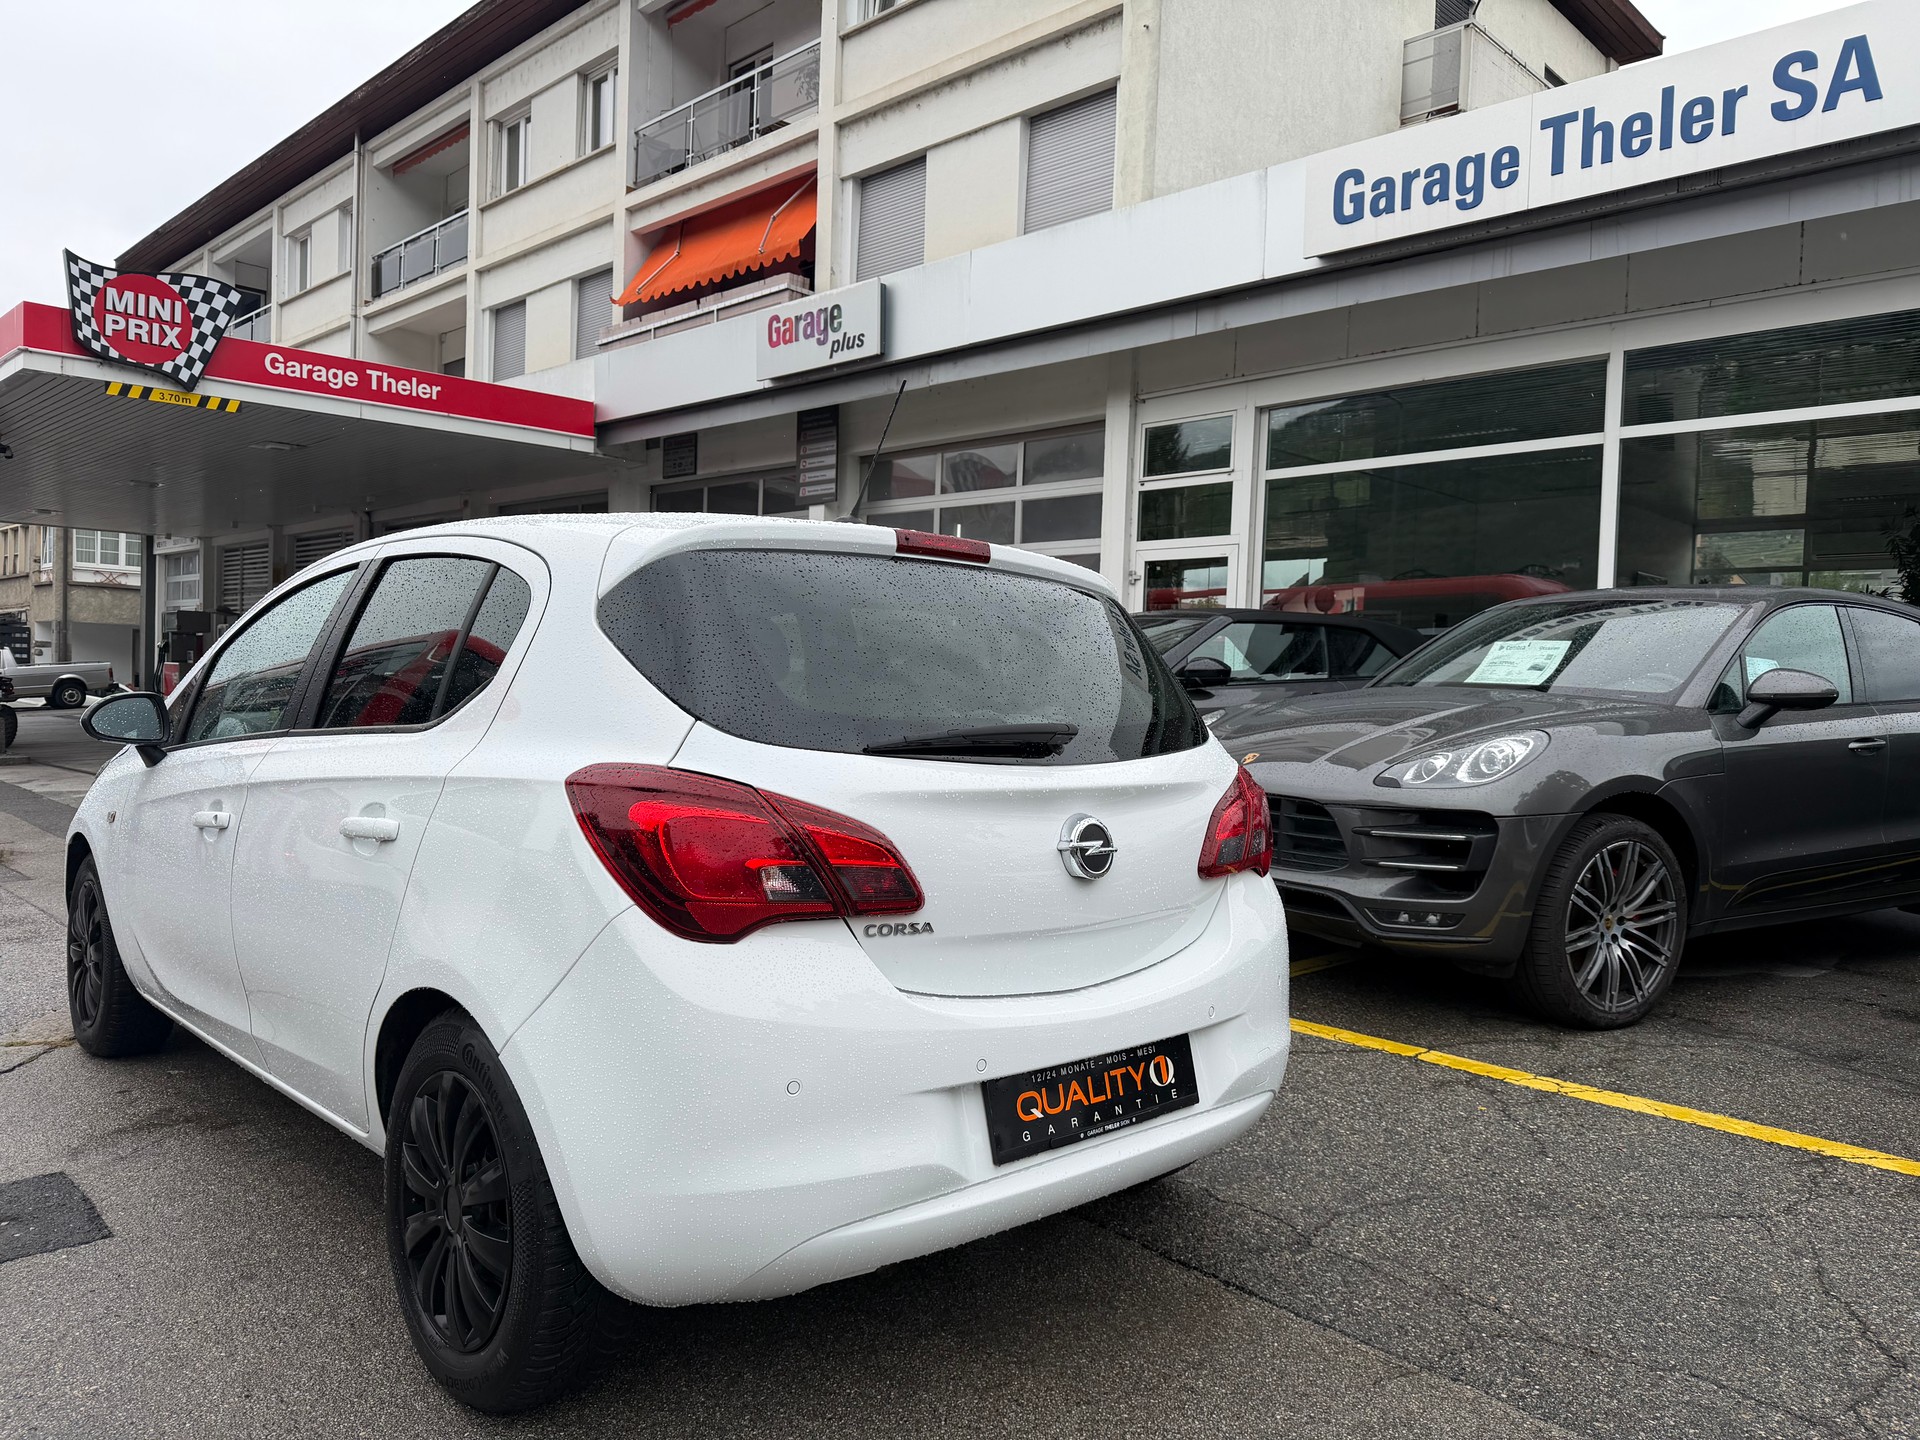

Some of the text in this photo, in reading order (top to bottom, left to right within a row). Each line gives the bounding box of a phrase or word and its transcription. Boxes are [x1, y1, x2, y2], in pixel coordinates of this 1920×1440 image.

[1332, 34, 1884, 225] Garage Theler SA
[105, 287, 182, 324] MINI
[104, 314, 182, 350] PRIX
[768, 304, 842, 349] Garage
[829, 331, 866, 360] plus
[264, 352, 442, 400] Garage Theler
[862, 921, 935, 938] CORSA
[1031, 1070, 1057, 1083] 12/24
[1060, 1060, 1096, 1076] MONATE
[1106, 1052, 1128, 1065] MOIS
[1137, 1046, 1156, 1057] MESI
[1016, 1062, 1146, 1122] QUALITY
[1022, 1088, 1178, 1142] GARANTIE
[1086, 1119, 1130, 1136] GARAGE THELER SION
